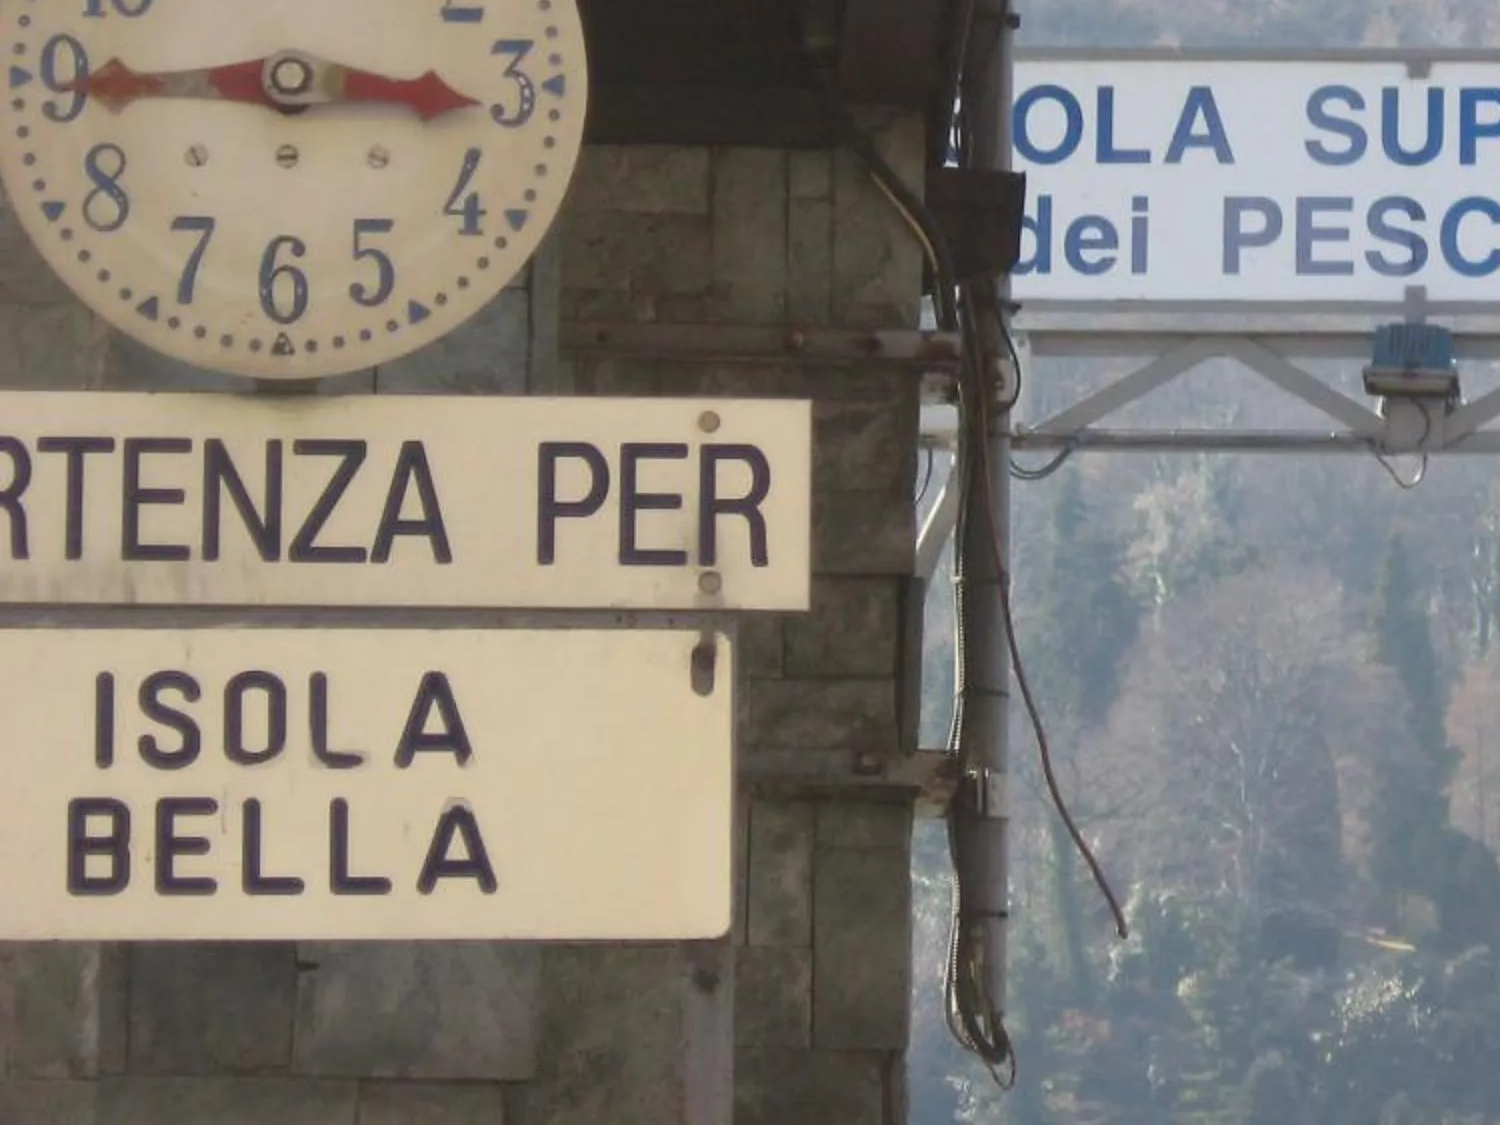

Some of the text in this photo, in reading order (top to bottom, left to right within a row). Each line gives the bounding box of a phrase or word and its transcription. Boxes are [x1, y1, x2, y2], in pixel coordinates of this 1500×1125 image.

[40, 34, 90, 123] 9
[490, 40, 535, 127] 3
[1012, 84, 1235, 165] OLA
[83, 143, 129, 232] 8
[444, 148, 486, 236] 4
[171, 217, 215, 304] 7
[349, 219, 395, 307] 5
[1016, 195, 1149, 276] dei
[258, 236, 308, 324] 6
[537, 441, 771, 568] PER
[95, 670, 473, 769] ISOLA
[67, 797, 497, 896] BELLA
